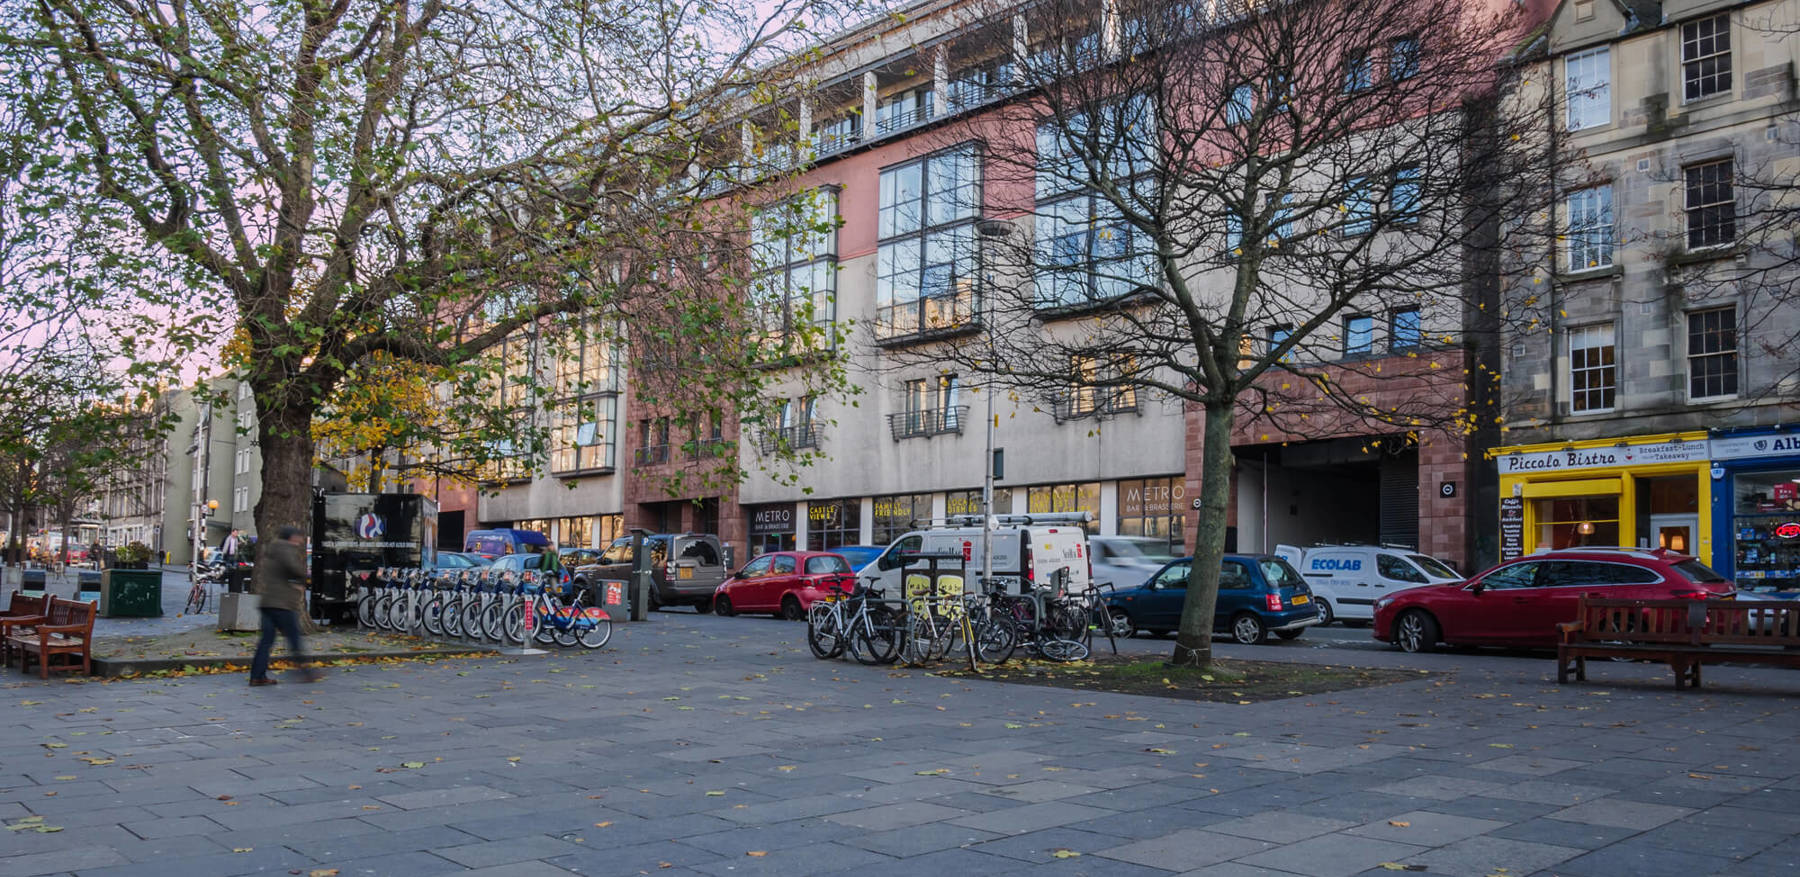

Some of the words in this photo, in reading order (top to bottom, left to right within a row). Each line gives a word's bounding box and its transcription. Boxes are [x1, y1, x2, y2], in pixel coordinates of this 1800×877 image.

[1508, 455, 1561, 471] Piccolo
[1567, 452, 1616, 467] Bistro
[1654, 451, 1690, 461] Takeaway
[1126, 485, 1185, 502] METRO
[809, 504, 835, 514] CASTLE
[1126, 504, 1140, 513] BAR
[755, 509, 790, 523] METRO
[809, 512, 831, 521] VIEWS
[1311, 558, 1362, 571] ECOLAB
